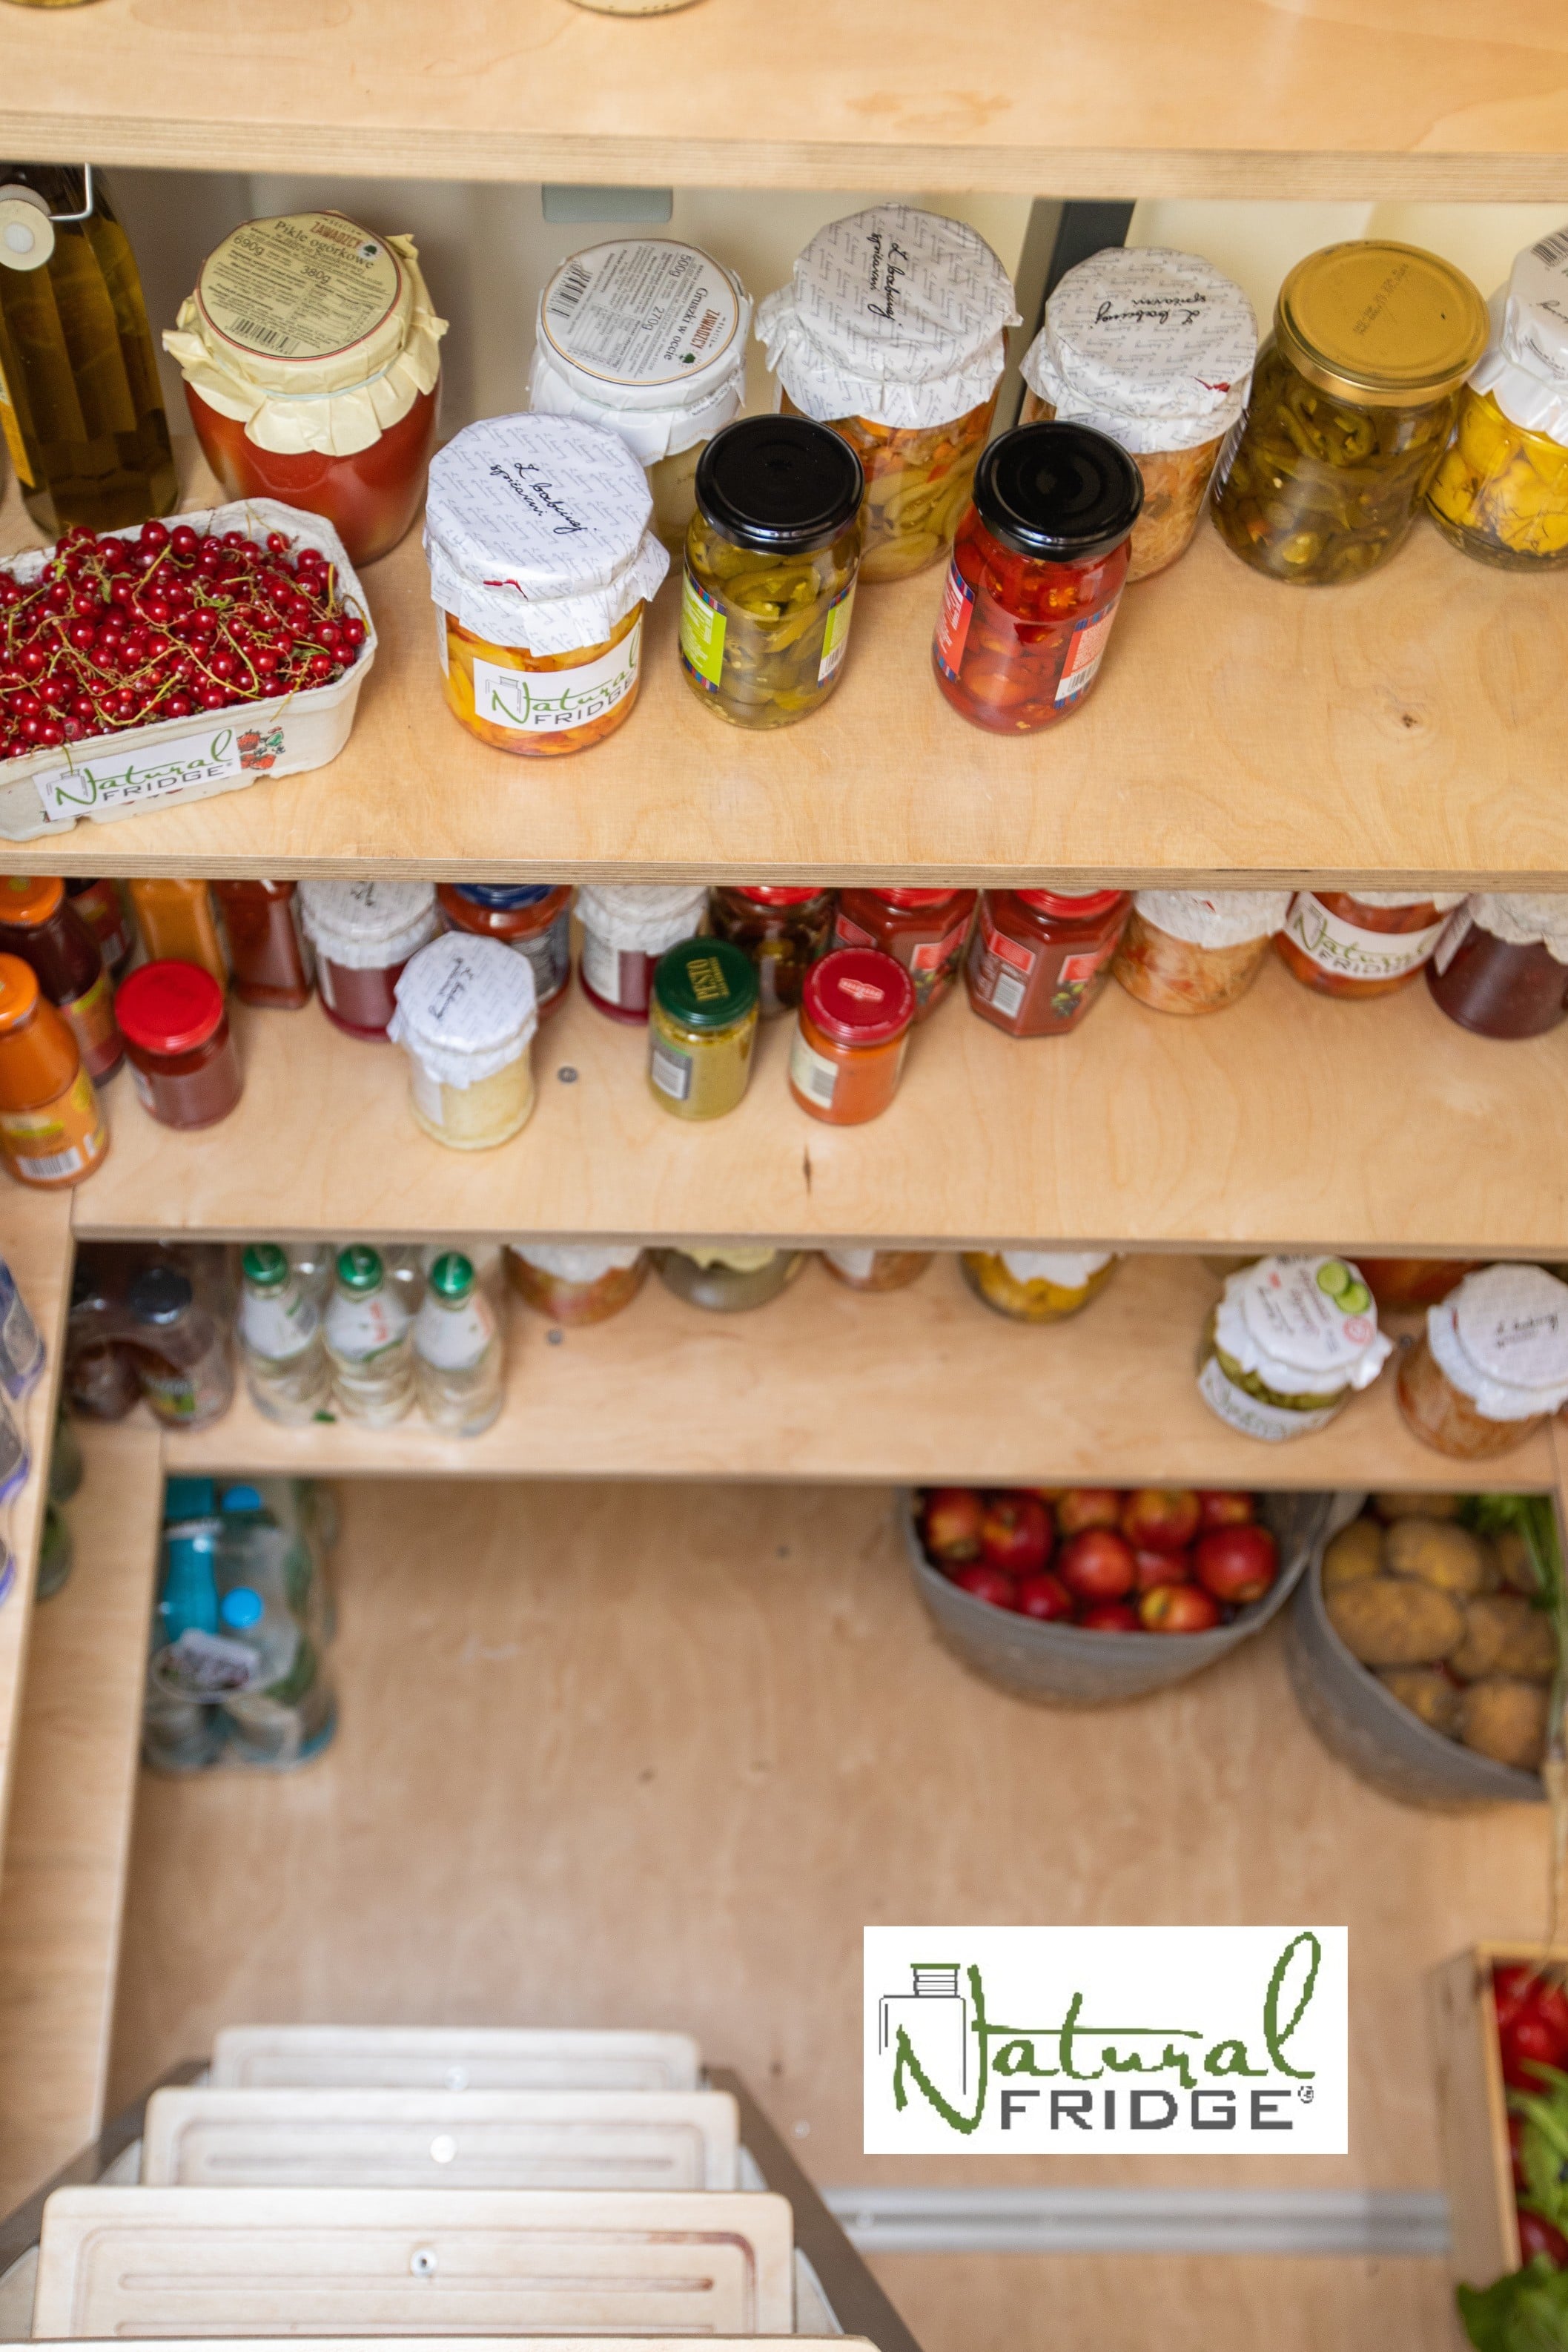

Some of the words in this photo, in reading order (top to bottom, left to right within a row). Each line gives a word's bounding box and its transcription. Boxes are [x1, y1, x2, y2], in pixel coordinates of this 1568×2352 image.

[234, 234, 264, 256] 690g
[274, 221, 308, 242] Pikle
[310, 240, 374, 269] ogórkowe
[300, 265, 331, 284] 380g
[669, 254, 692, 277] 500g
[641, 306, 664, 331] 270g
[682, 288, 708, 325] Gruszki
[678, 326, 687, 334] w
[690, 308, 721, 349] ZAWADZCY
[664, 335, 681, 360] occie
[492, 623, 641, 724] Natural
[534, 675, 634, 724] FRIDGE
[56, 729, 233, 806] Natural
